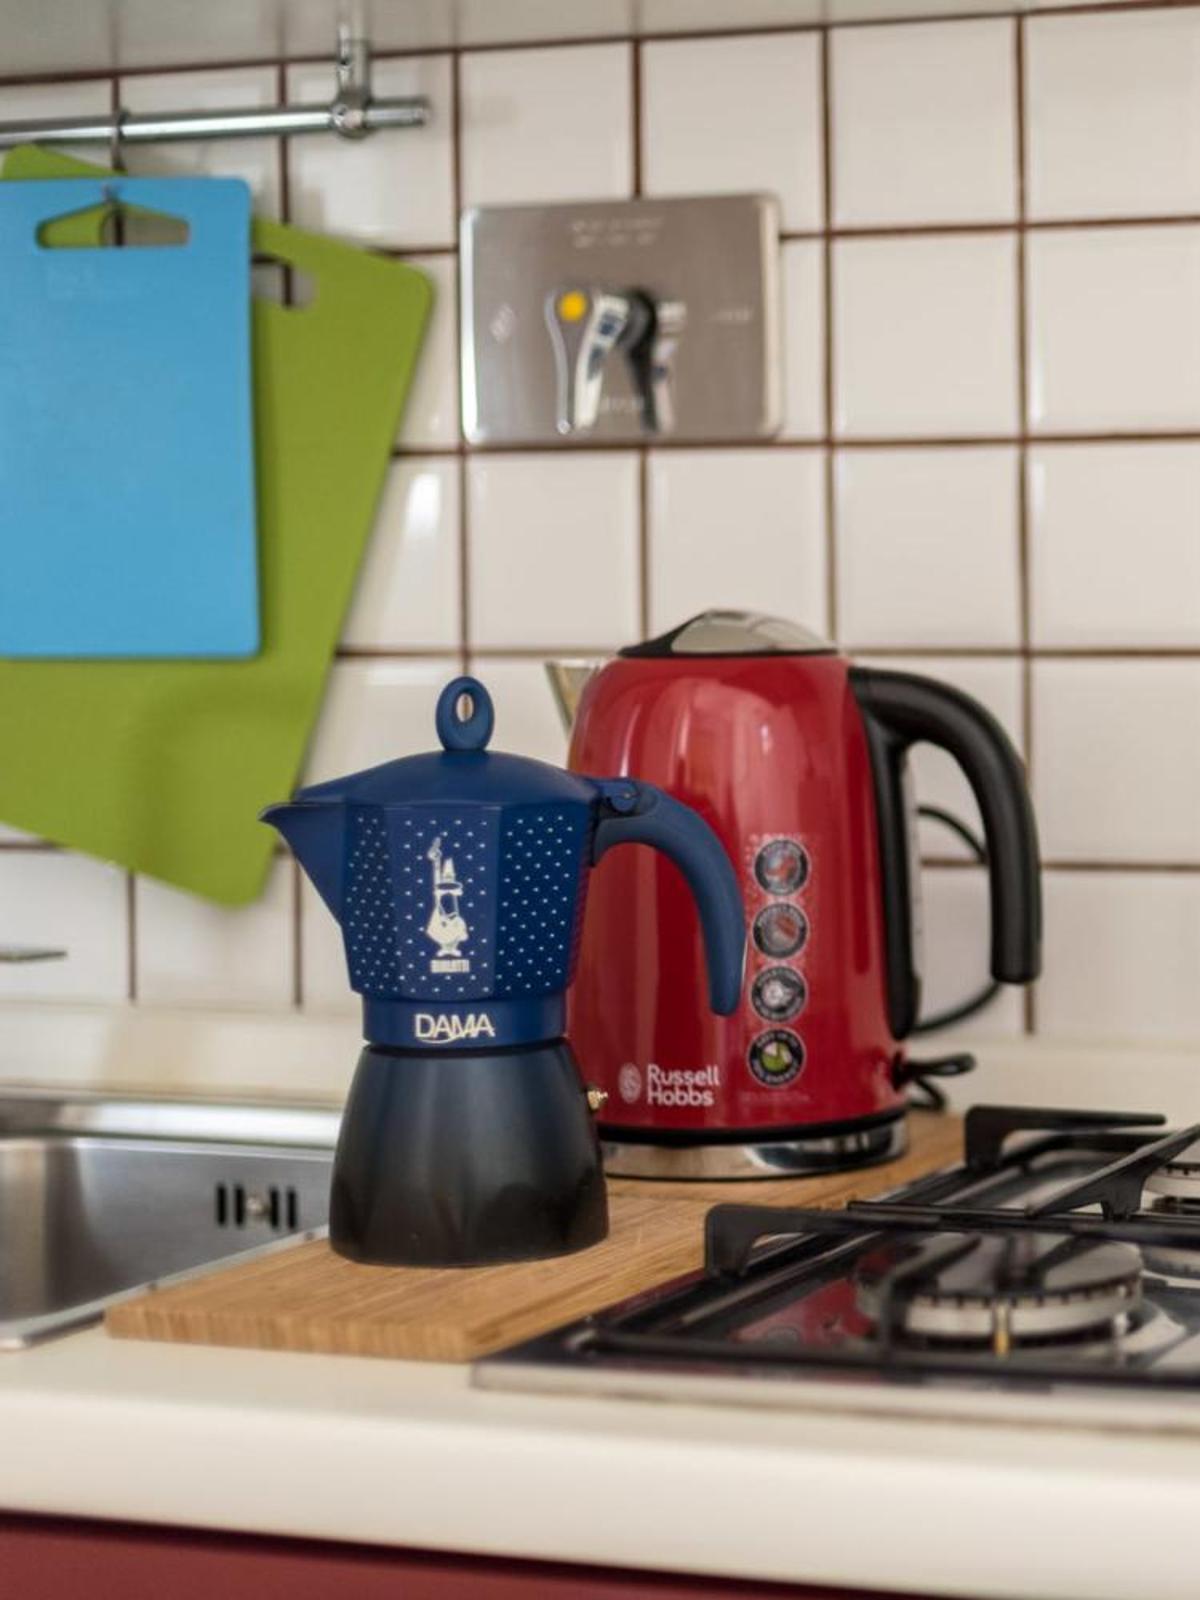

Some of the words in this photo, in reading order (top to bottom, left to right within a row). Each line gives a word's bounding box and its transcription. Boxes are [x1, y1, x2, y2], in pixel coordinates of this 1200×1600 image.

[415, 1014, 495, 1041] DAMA
[647, 1063, 720, 1086] Russell
[647, 1085, 714, 1106] Hobbs
